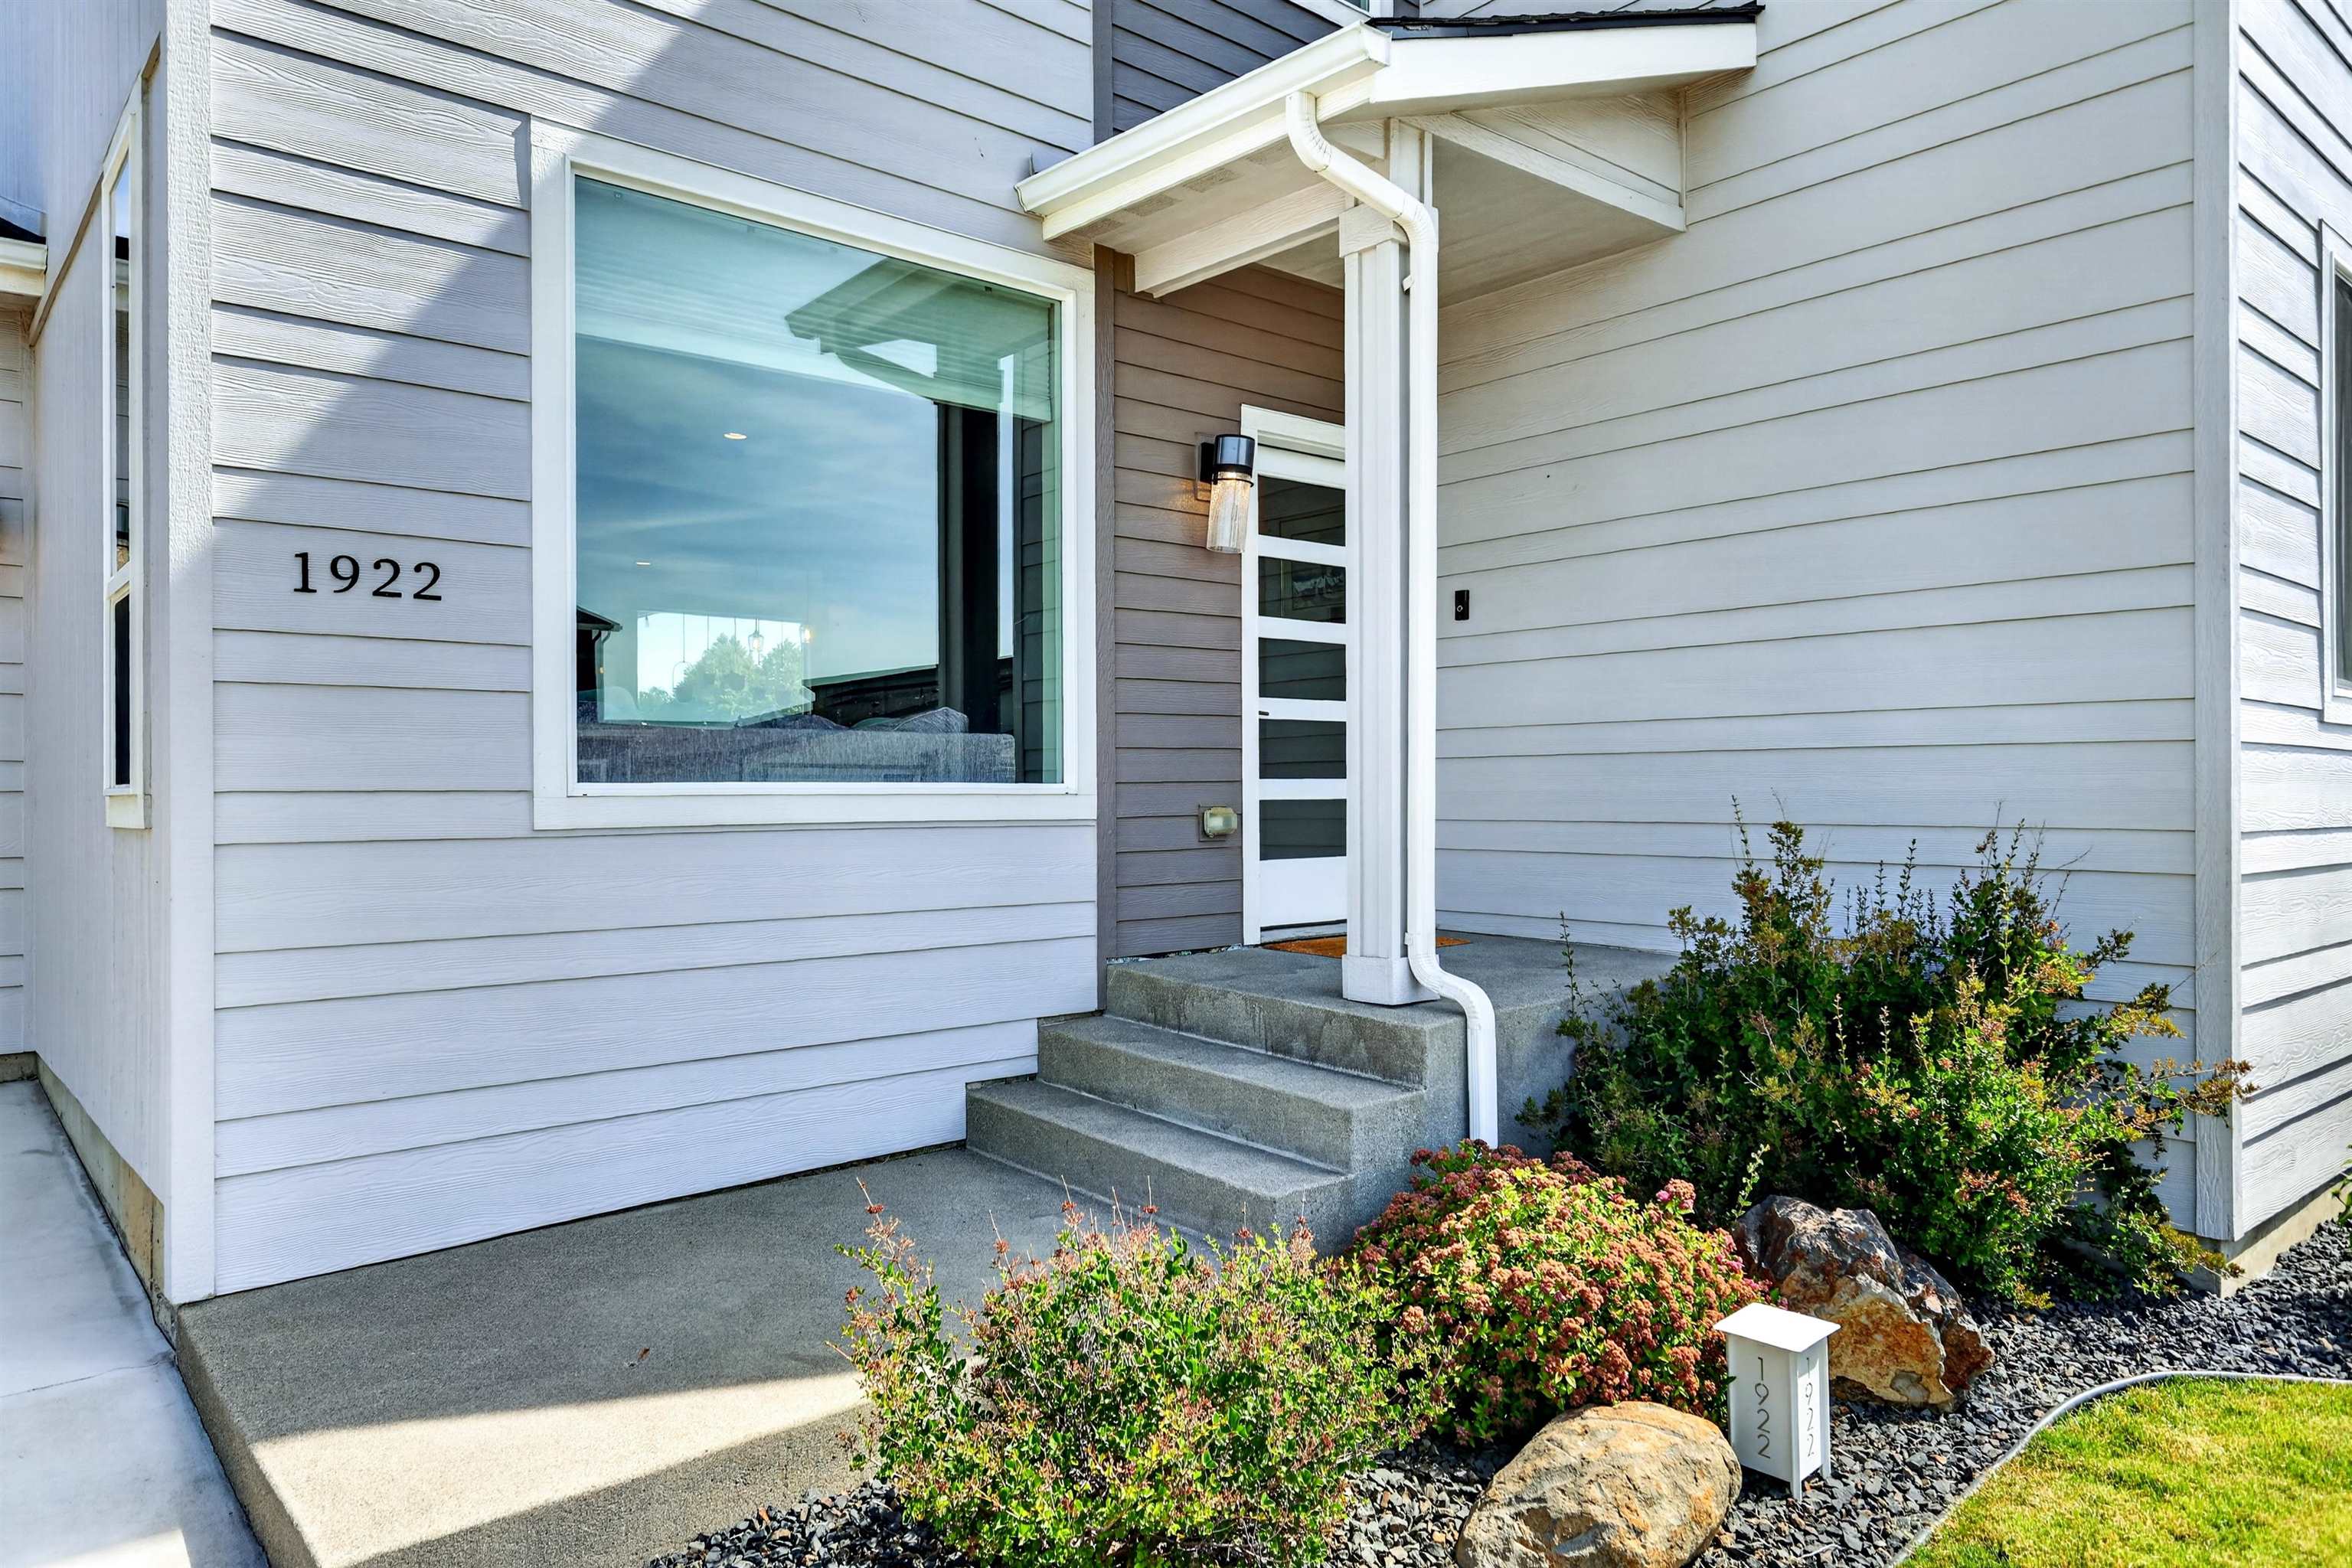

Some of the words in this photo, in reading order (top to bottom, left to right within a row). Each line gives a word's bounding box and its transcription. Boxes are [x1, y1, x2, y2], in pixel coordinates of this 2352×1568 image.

[293, 551, 443, 601] 1922
[1754, 1357, 1771, 1459] 1922
[1805, 1357, 1815, 1458] 1922
